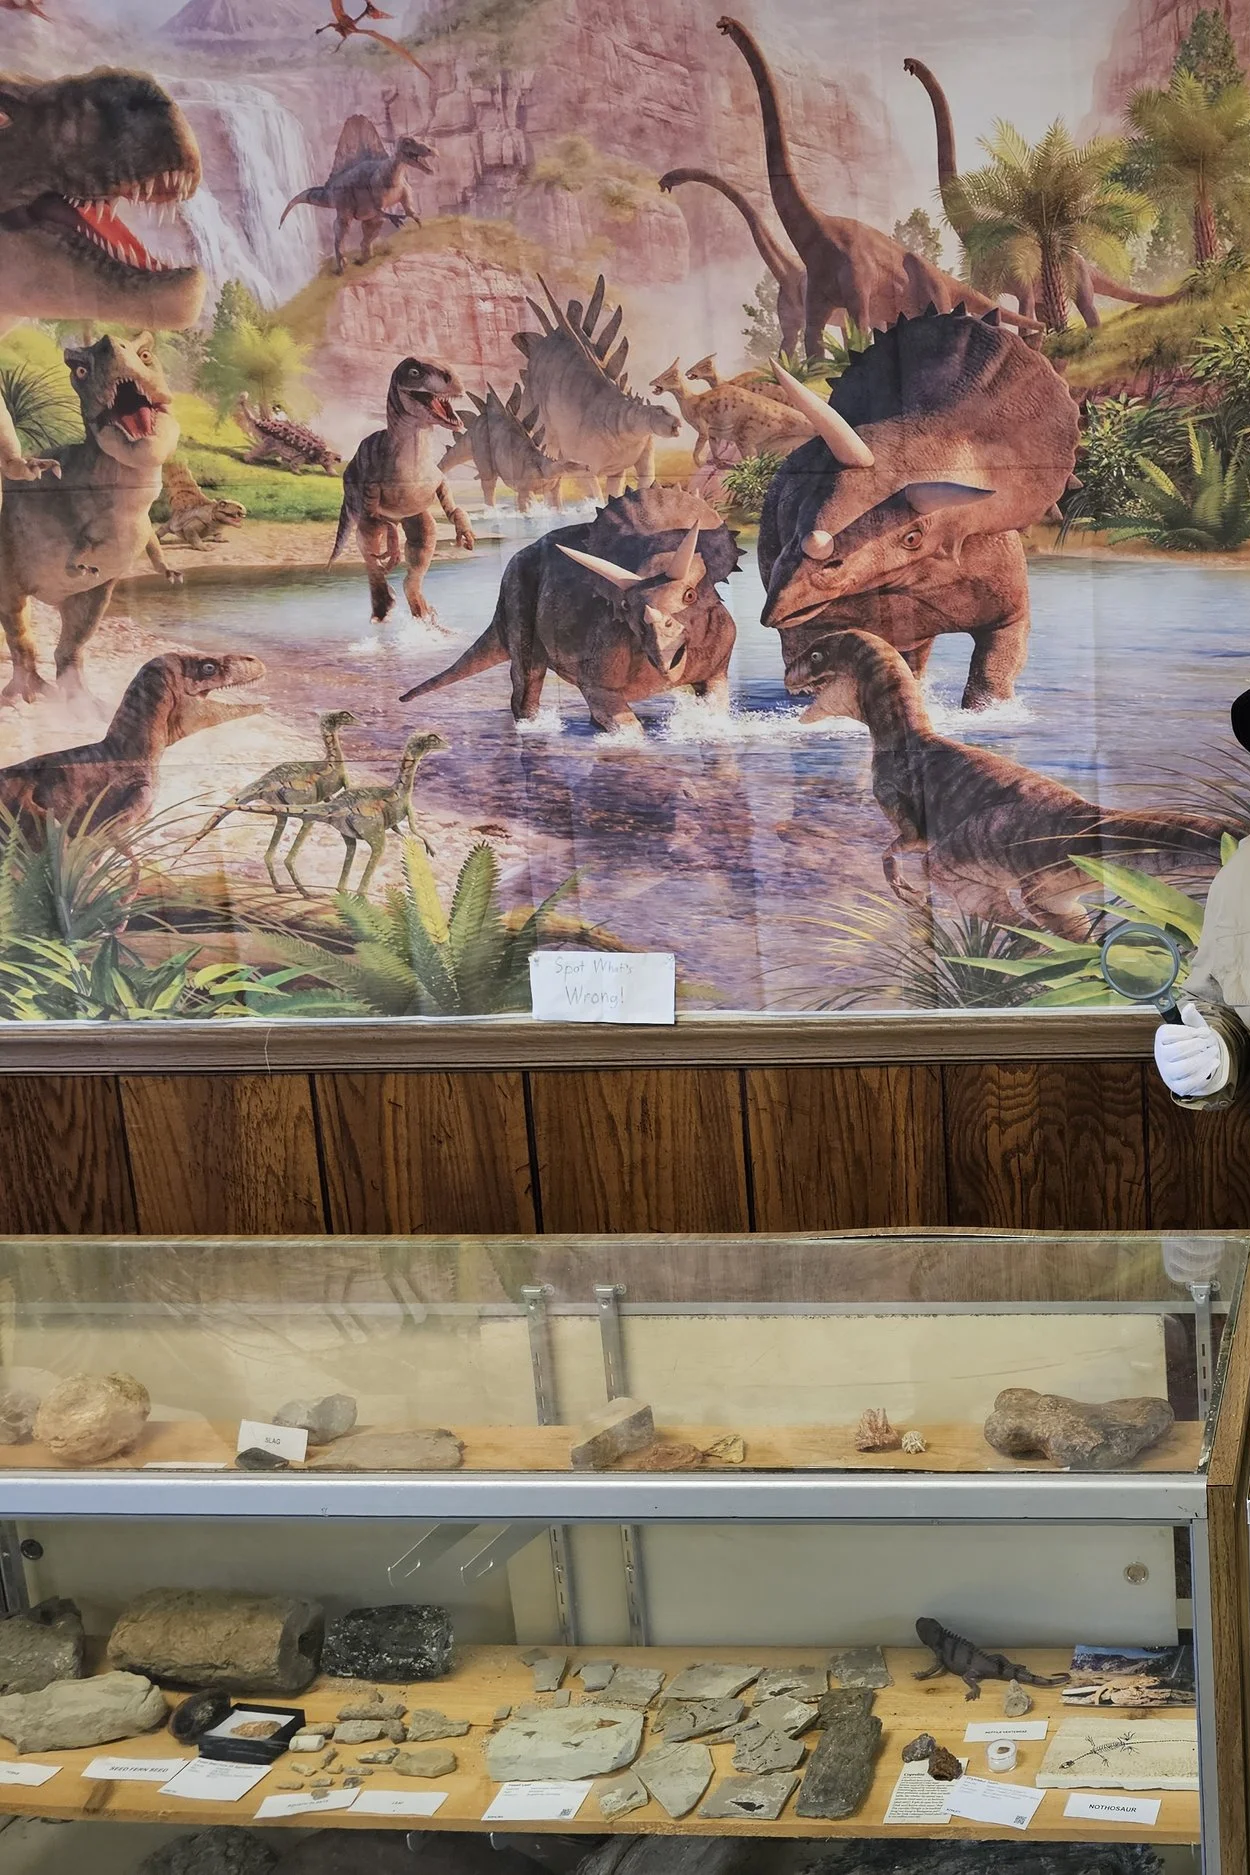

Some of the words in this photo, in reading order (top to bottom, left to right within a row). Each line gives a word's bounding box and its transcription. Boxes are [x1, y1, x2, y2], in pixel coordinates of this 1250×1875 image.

[555, 956, 584, 982] Spot
[594, 958, 633, 974] What's
[565, 986, 624, 1008] Wrong!
[1088, 1804, 1136, 1812] NOTHOSAUR
